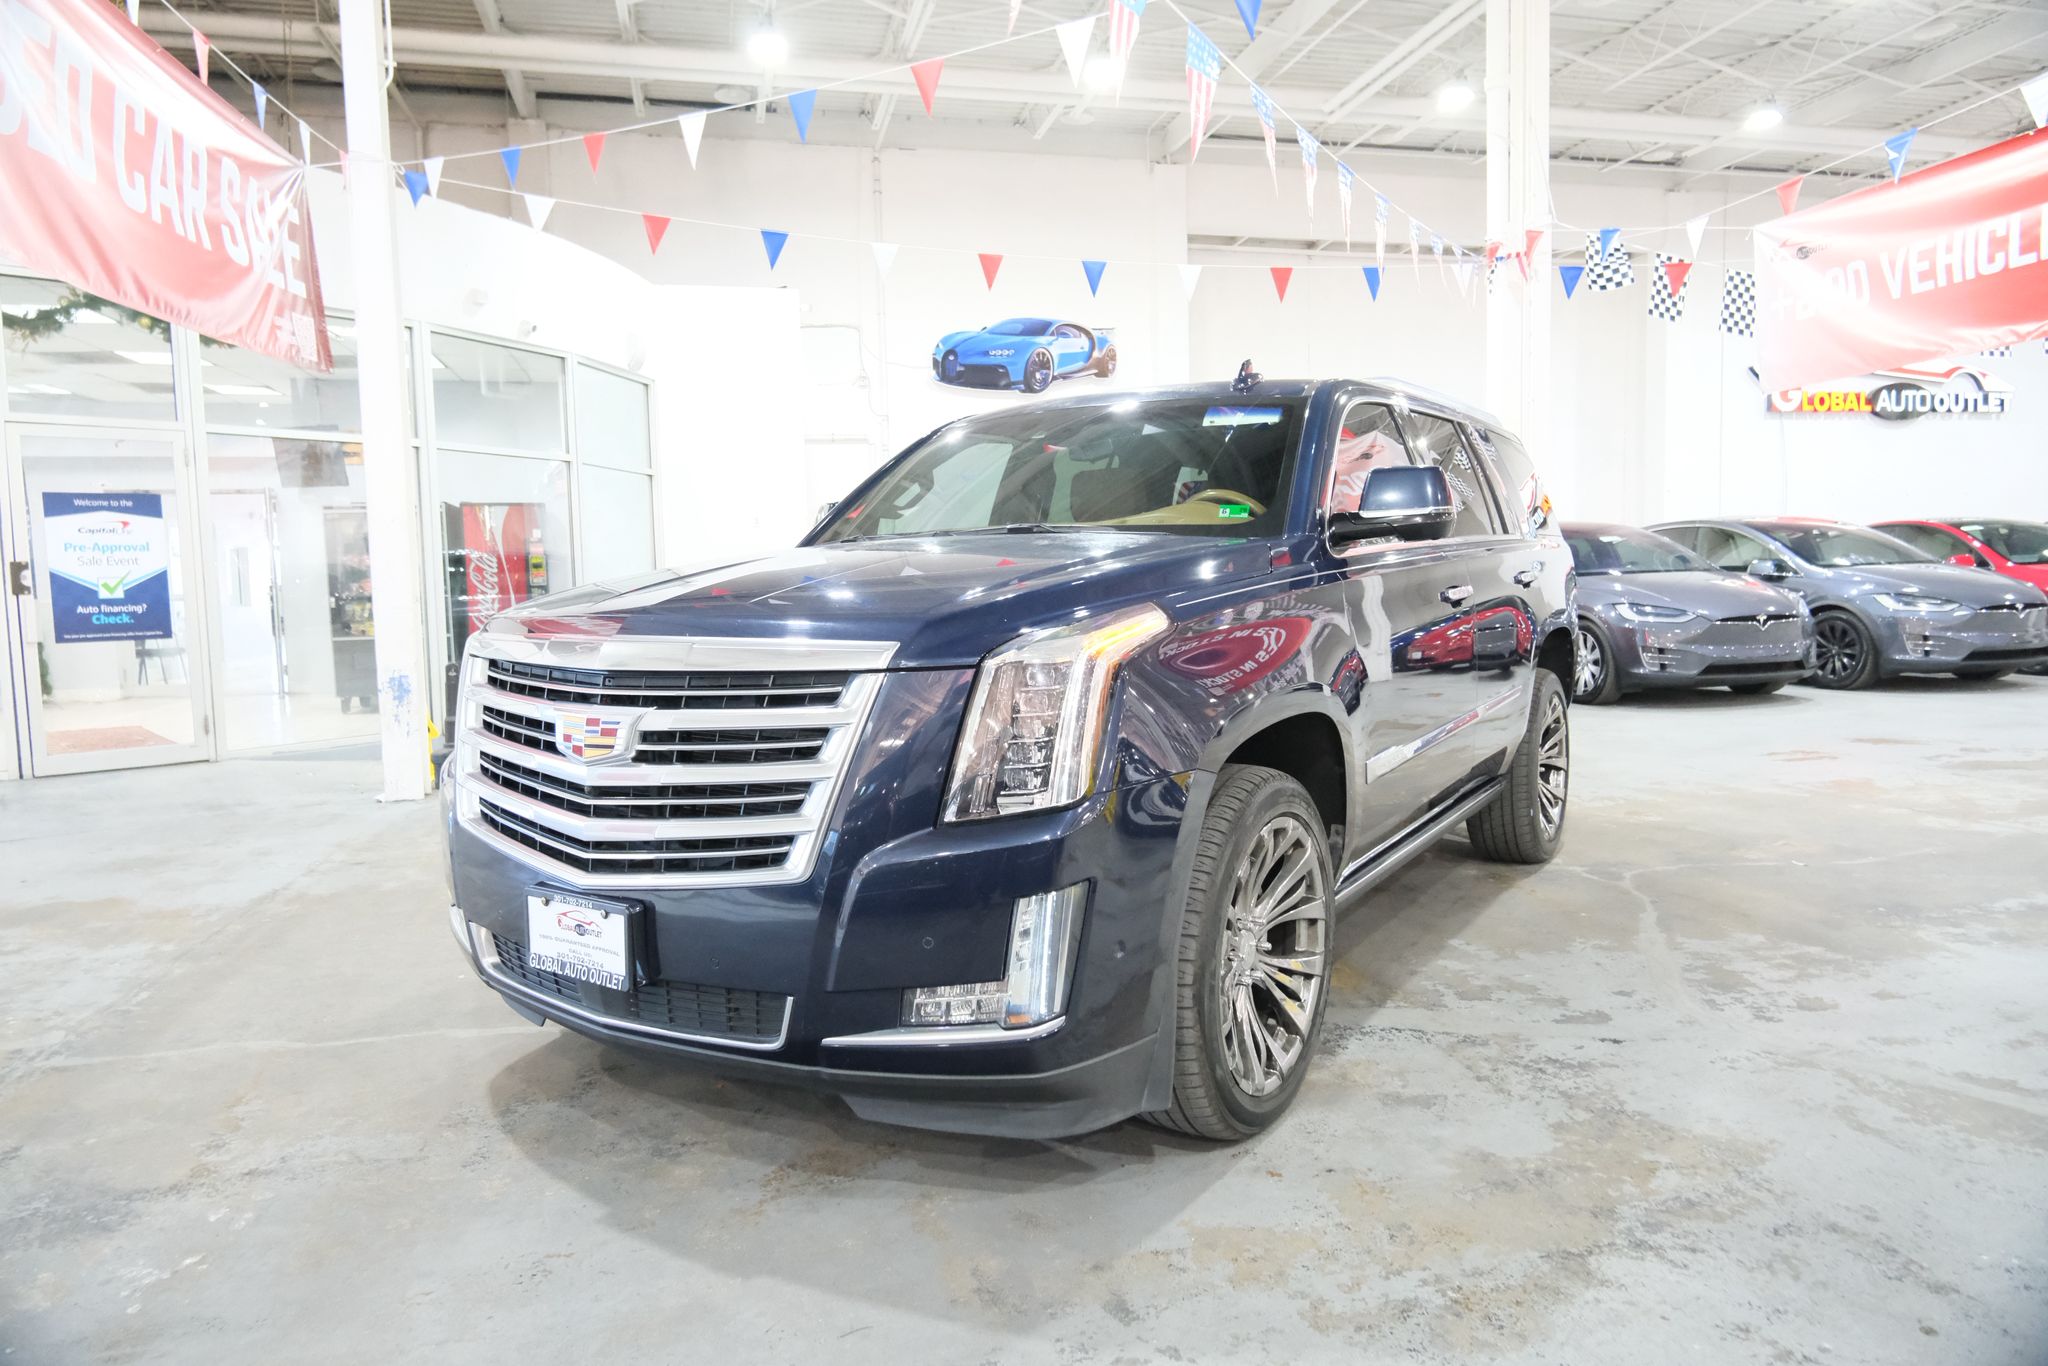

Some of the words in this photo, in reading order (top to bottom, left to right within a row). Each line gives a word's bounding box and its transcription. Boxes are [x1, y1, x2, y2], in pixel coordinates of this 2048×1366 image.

[0, 2, 97, 184] ED
[113, 83, 212, 251] CAR
[220, 156, 307, 299] SALE
[1771, 388, 1872, 412] GLOBAL
[1876, 389, 1932, 412] AUTO
[1934, 391, 2014, 412] OUTLET
[73, 498, 109, 507] Welcome
[110, 499, 119, 507] to
[120, 499, 133, 507] the
[64, 541, 150, 555] Pre-Approval
[77, 556, 102, 567] Sale
[106, 556, 140, 567] Event
[77, 604, 99, 614] Auto
[101, 603, 147, 615] financing?
[92, 613, 134, 625] Check.
[529, 953, 563, 975] GLOBAL
[564, 961, 588, 981] AUTO
[589, 967, 625, 991] OUTLET
